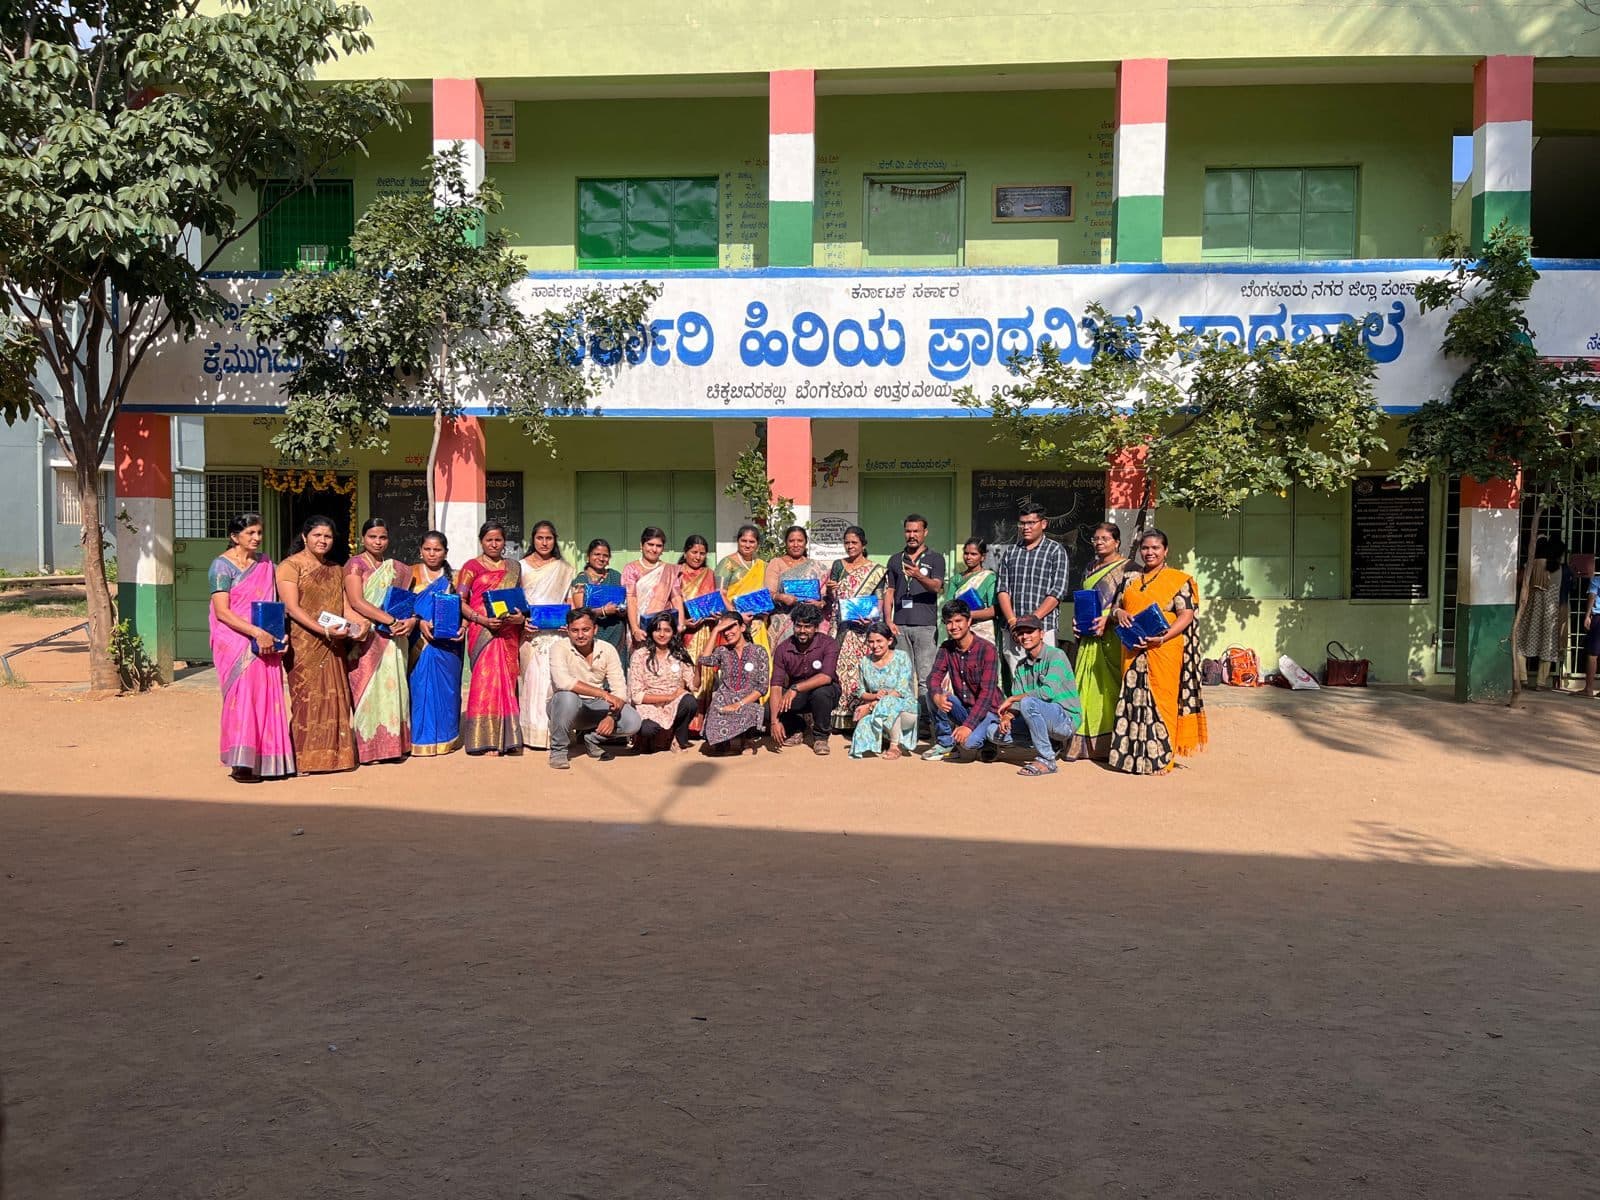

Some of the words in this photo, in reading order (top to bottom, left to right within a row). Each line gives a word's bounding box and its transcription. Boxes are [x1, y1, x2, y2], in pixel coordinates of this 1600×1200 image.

[851, 283, 907, 299] ಕರ್ನಾಟಕ
[912, 282, 960, 298] ಸರ್ಕಾರ
[1240, 280, 1308, 298] ಬೆಂಗಳೂರು
[1311, 280, 1344, 299] ನಗರ
[1348, 281, 1377, 301] ಜಿಲ್ಲಾ
[738, 301, 904, 368] ಹಿರಿಯ
[706, 381, 787, 405] ಚಿಕ್ಕಬಿದರಕಲ್ಲು
[796, 380, 867, 399] ಬೆಂಗಳೂರು
